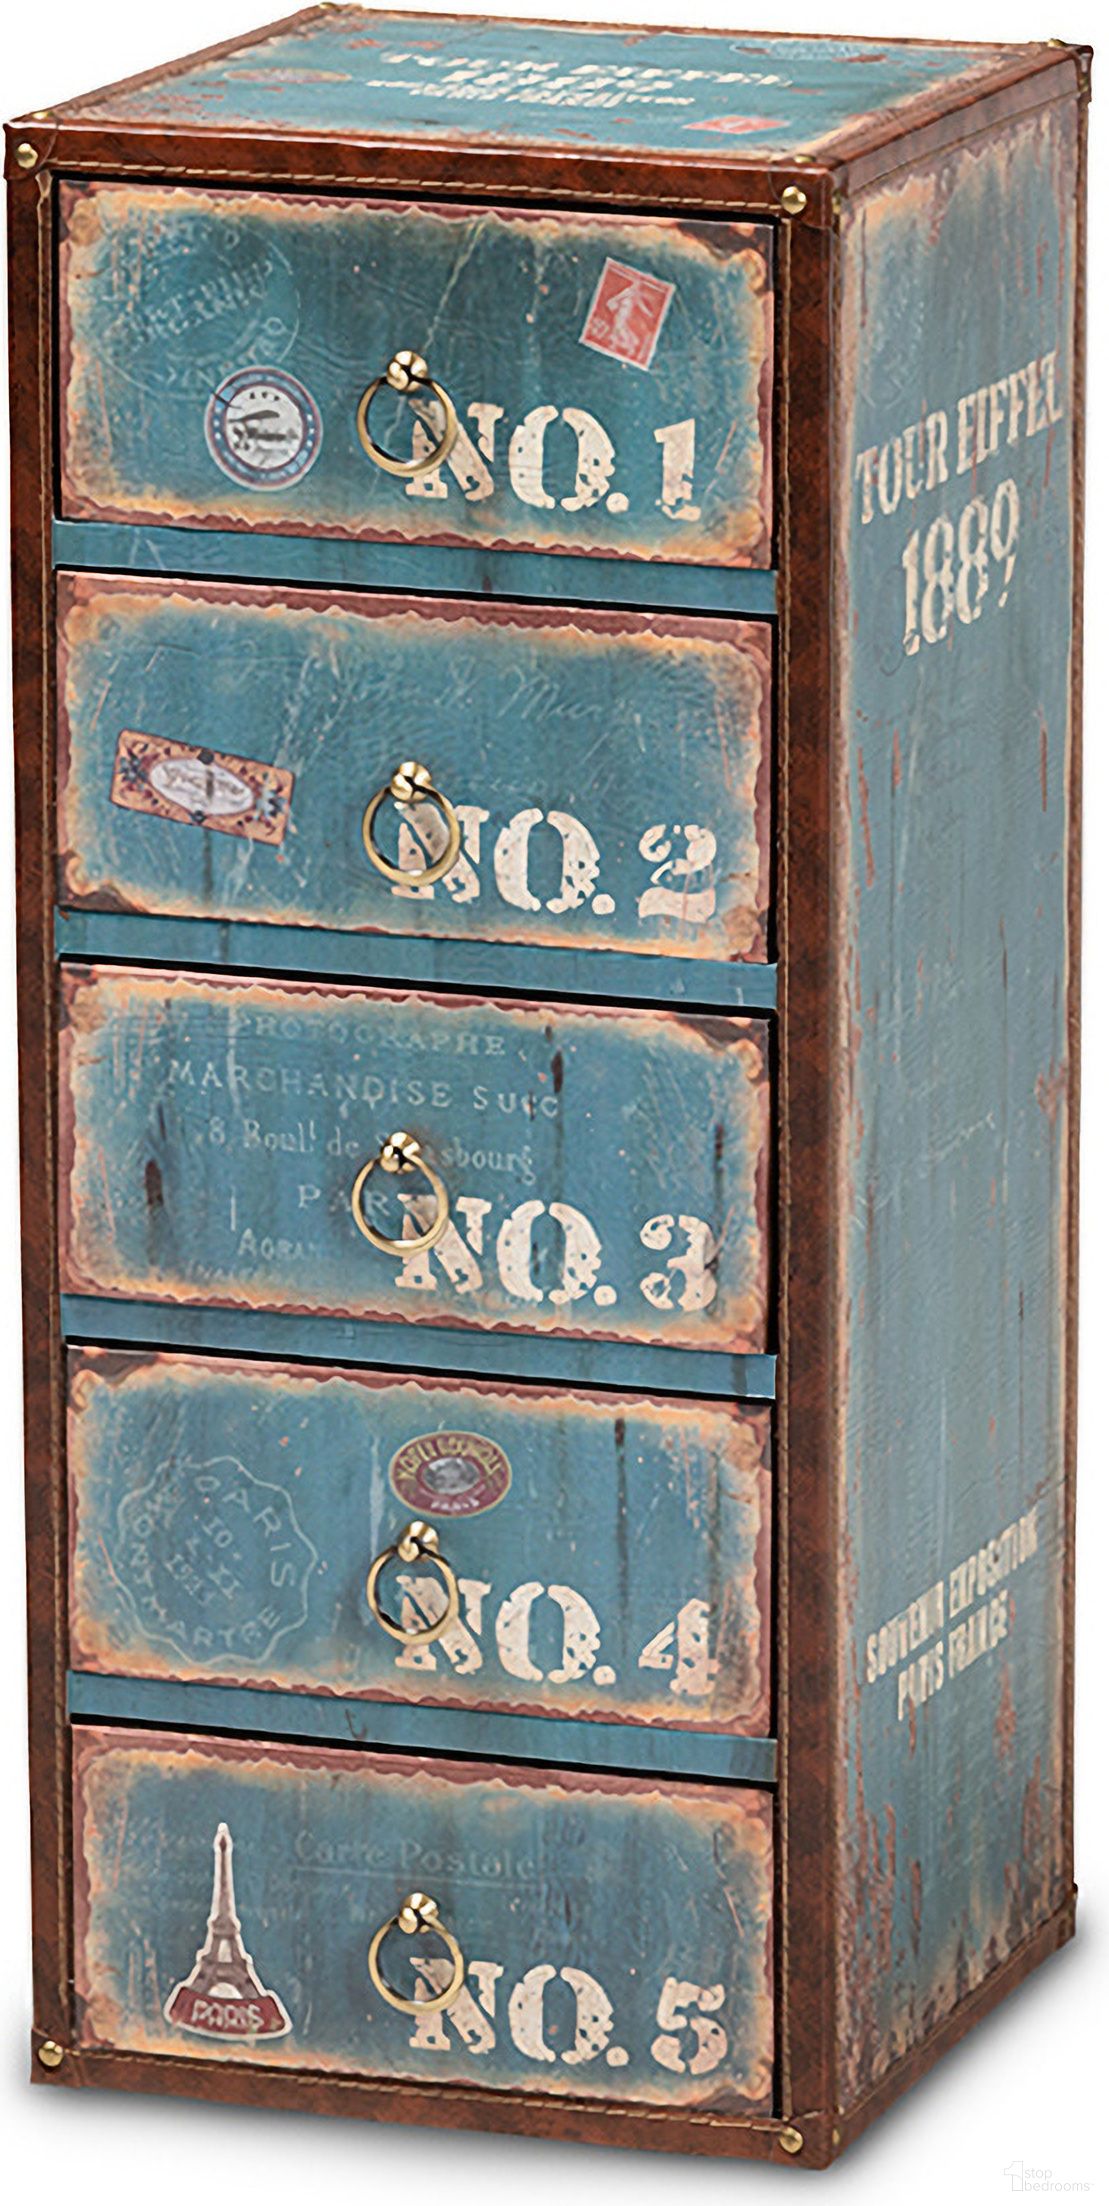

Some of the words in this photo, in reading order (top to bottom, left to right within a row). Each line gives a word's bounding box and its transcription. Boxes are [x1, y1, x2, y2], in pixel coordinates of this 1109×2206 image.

[854, 410, 950, 525] TOUR
[955, 350, 1064, 476] EIFFEL
[901, 477, 1020, 657] 1889
[166, 1058, 452, 1109] MARCHANDISE
[327, 1125, 360, 1157] de
